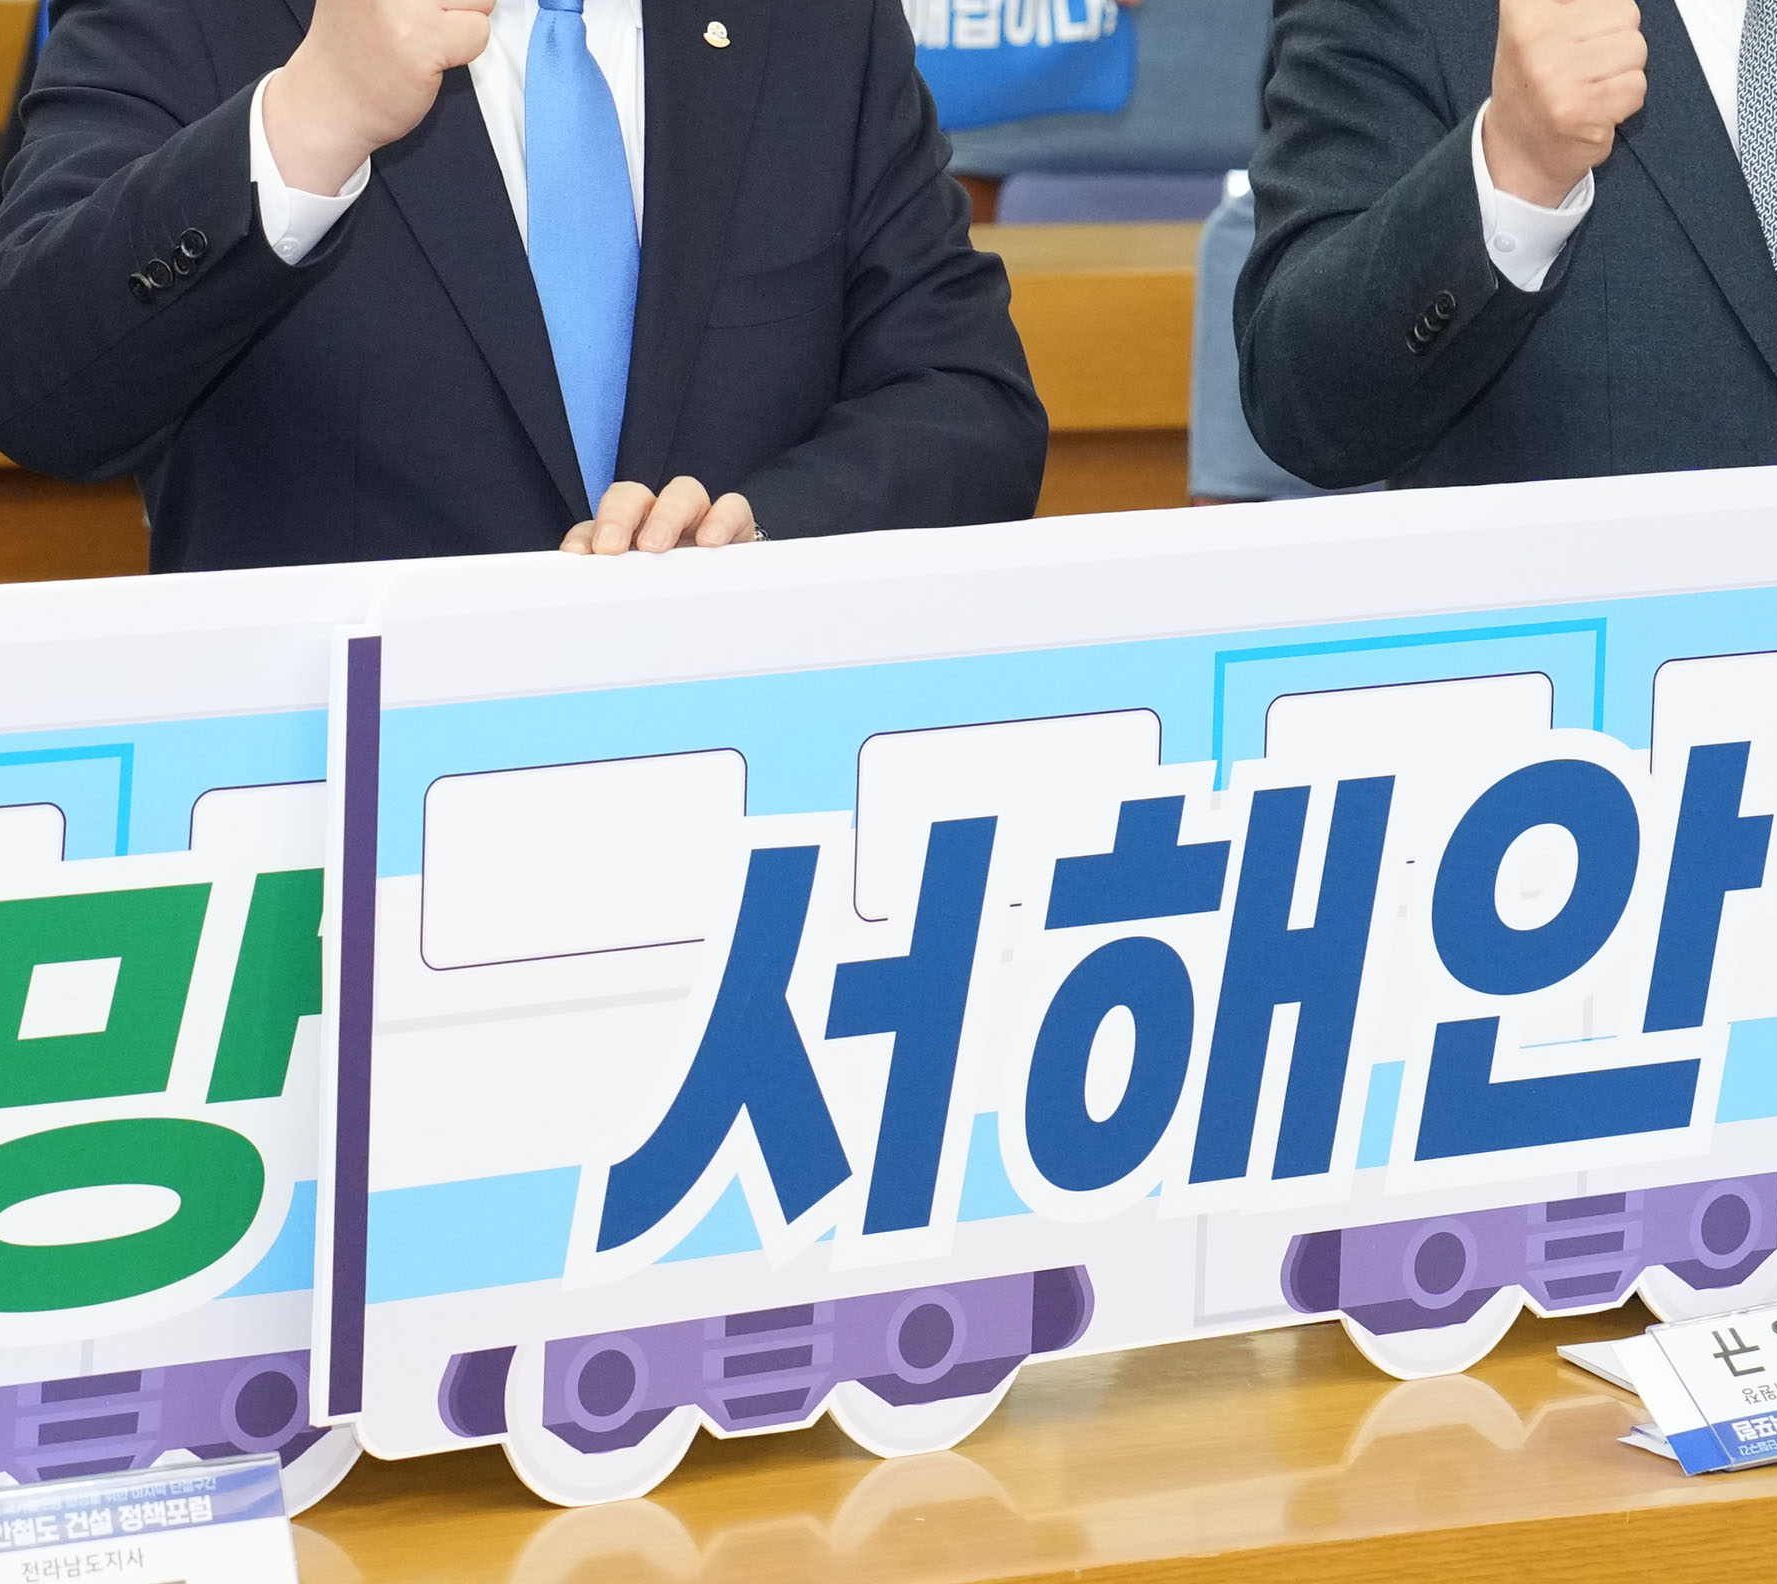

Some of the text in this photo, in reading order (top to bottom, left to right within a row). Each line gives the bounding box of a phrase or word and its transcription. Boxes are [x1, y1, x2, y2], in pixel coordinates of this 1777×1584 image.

[594, 740, 1775, 1253] 서해안
[64, 1507, 114, 1539] 건설
[117, 1494, 214, 1533] 정책포럼
[21, 1546, 146, 1584] 전라남도지사
